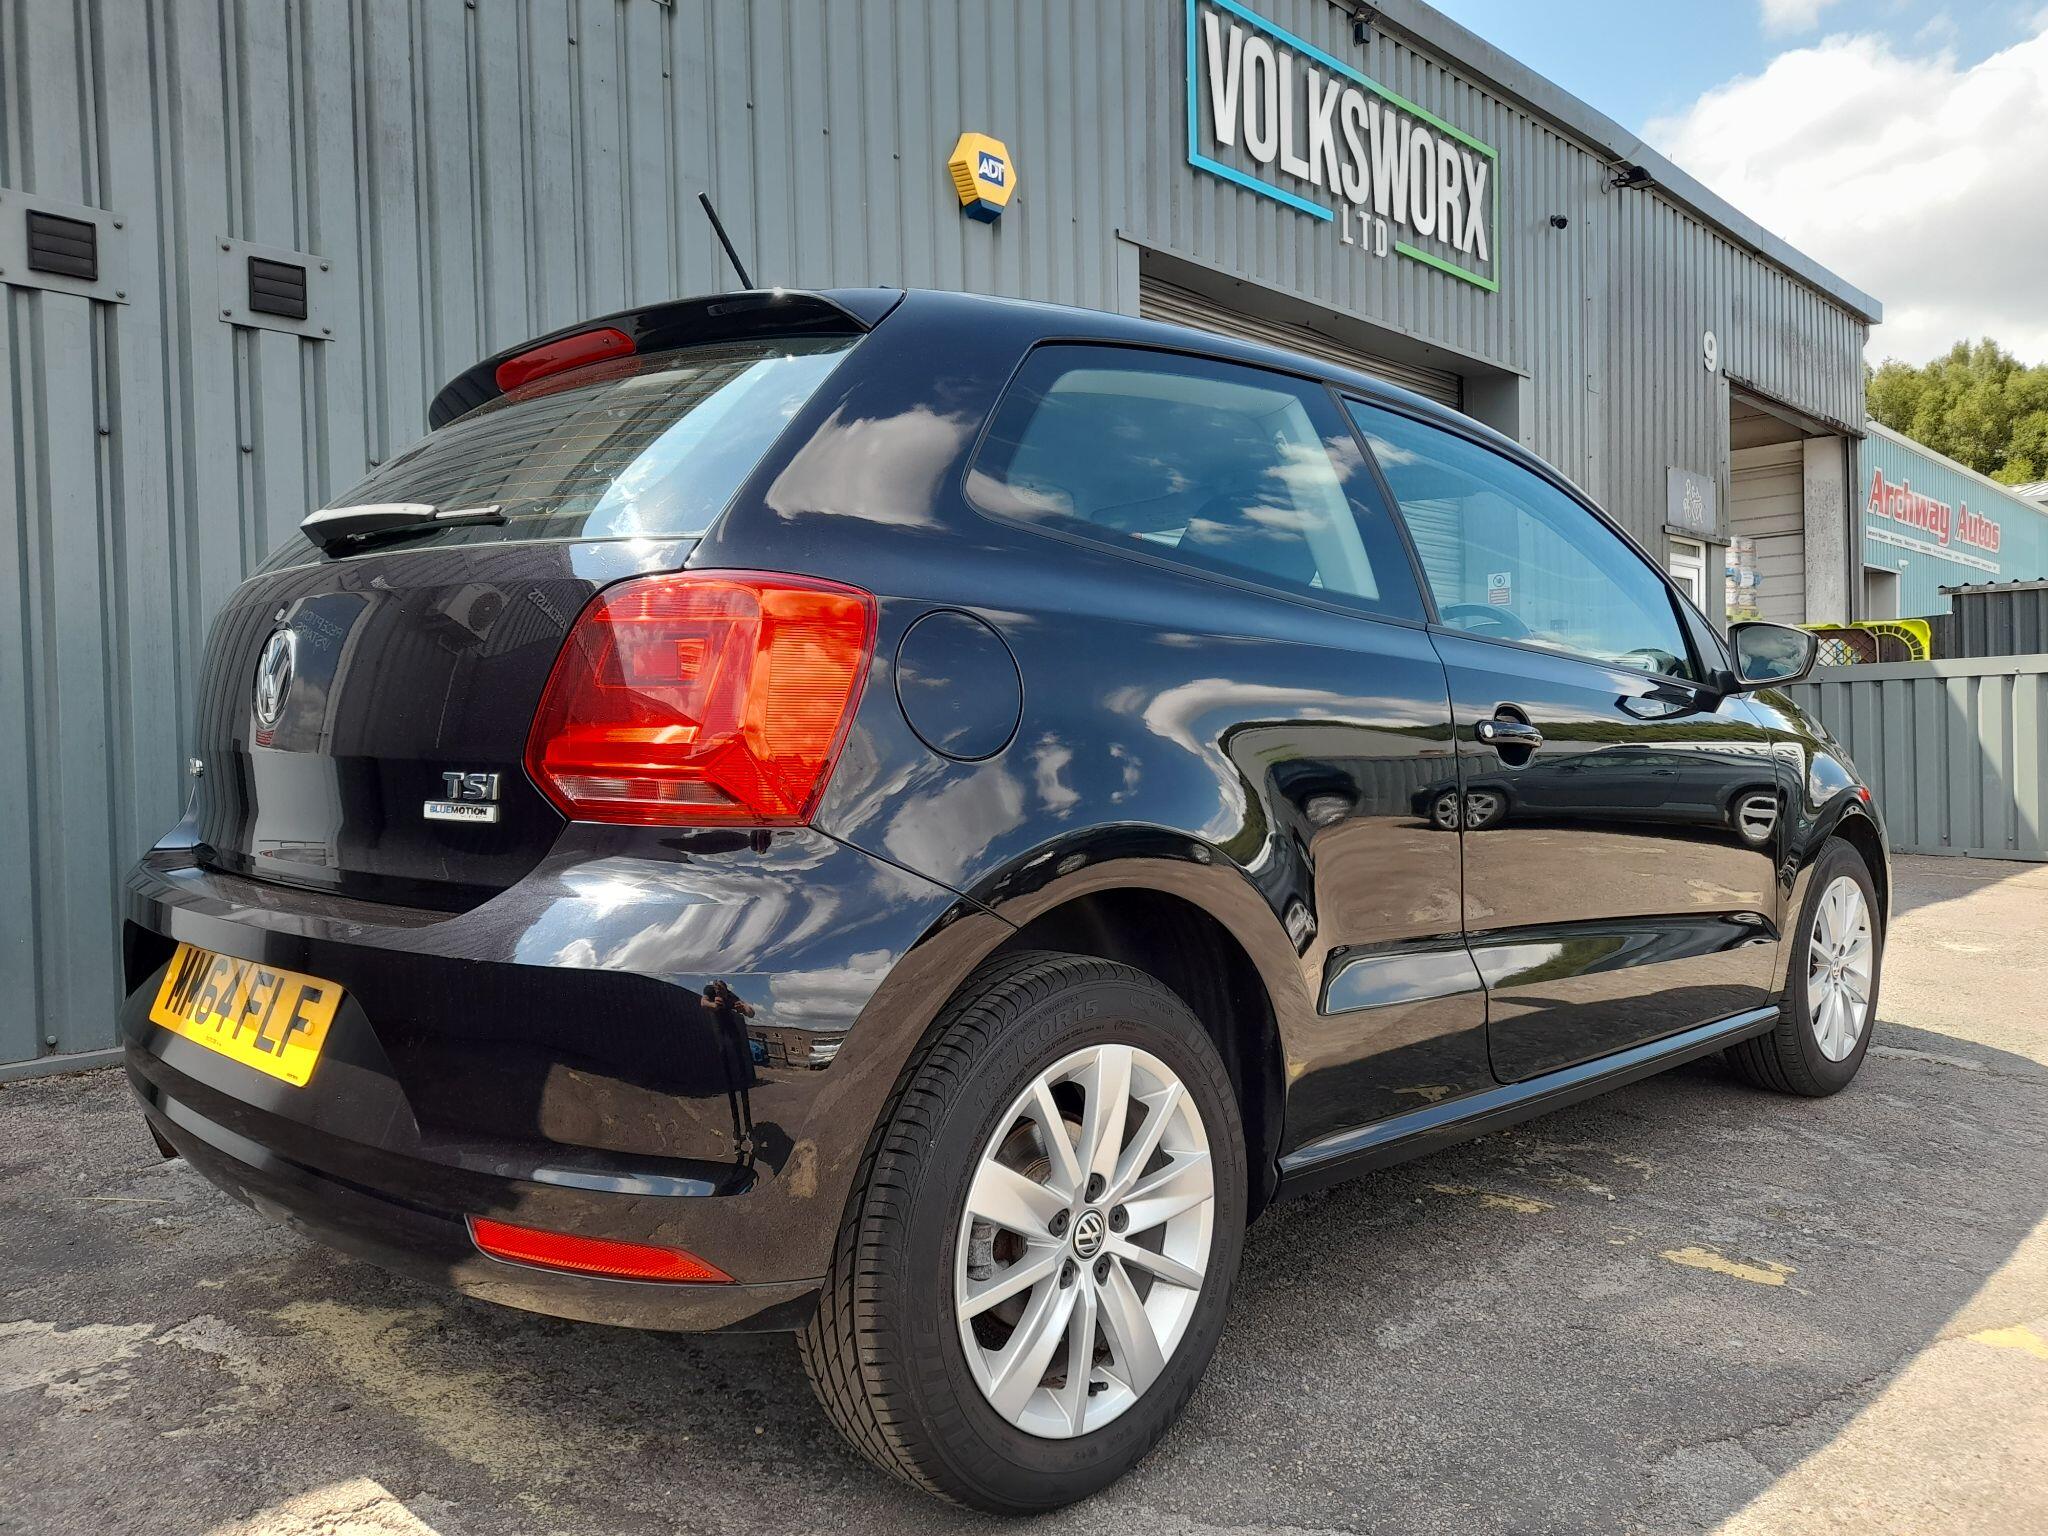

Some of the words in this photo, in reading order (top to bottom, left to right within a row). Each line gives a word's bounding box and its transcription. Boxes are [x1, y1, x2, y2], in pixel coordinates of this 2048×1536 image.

[1205, 11, 1488, 261] VOLKSWORX
[979, 157, 1004, 181] ADT
[1341, 203, 1388, 258] LTD
[1703, 330, 1718, 373] 9
[1867, 468, 1951, 546] Archway
[1955, 502, 2000, 553] Autos
[429, 804, 487, 816] BLUEMOTION
[442, 772, 498, 800] TSI
[164, 947, 246, 1033] MM64
[231, 969, 323, 1058] FLF
